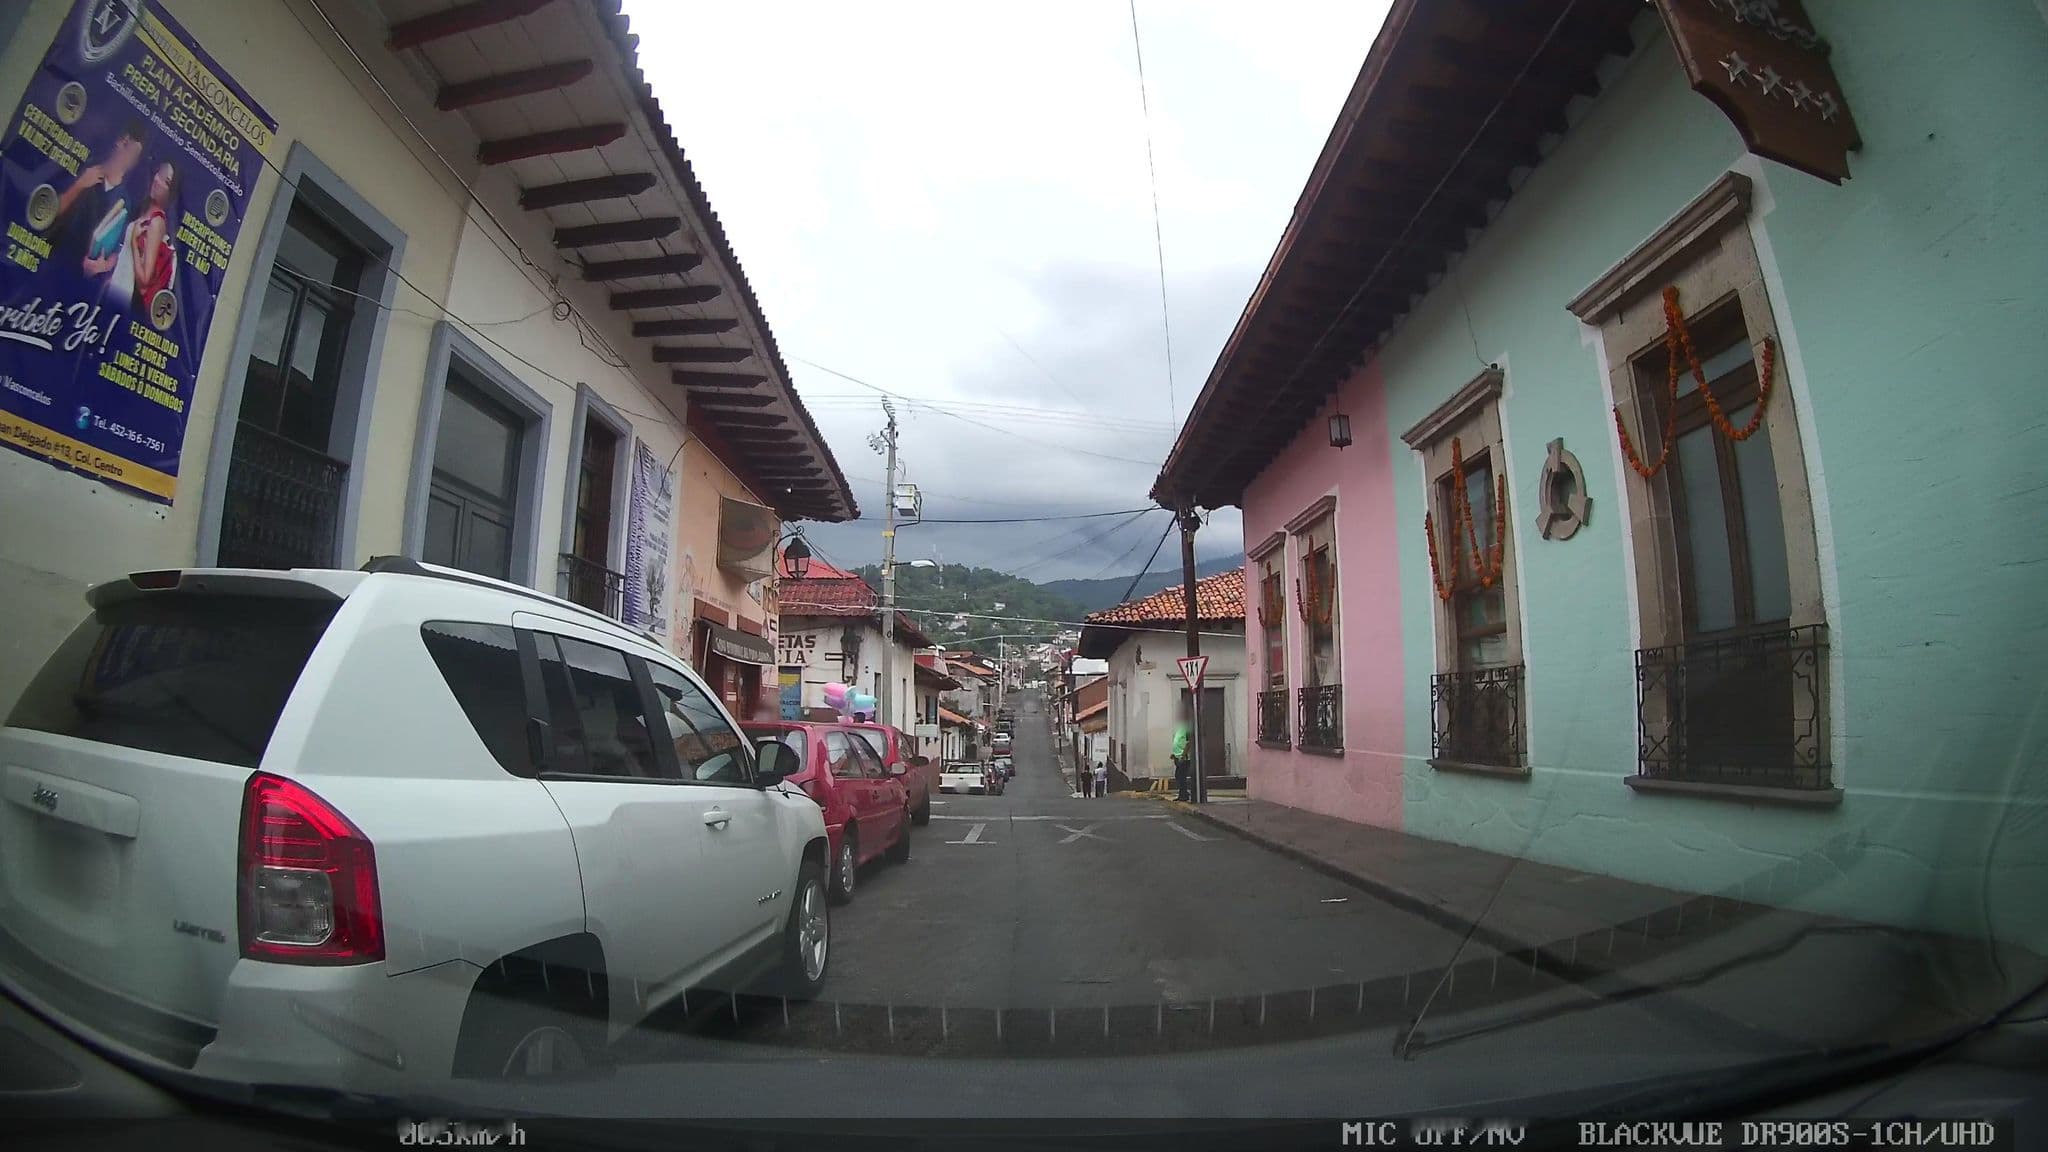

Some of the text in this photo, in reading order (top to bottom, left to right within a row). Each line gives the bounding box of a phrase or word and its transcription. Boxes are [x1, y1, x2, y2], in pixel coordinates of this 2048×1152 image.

[105, 72, 150, 117] Bachillerato
[151, 111, 185, 146] Intensivo
[124, 63, 240, 176] PREPA Y SECUNDARIA
[143, 54, 240, 151] PLAN ACADÉMICO
[187, 58, 267, 147] VASCONCELOS
[6, 244, 17, 260] 2
[65, 302, 120, 354] Ya!
[130, 321, 179, 358] FLEXIBILIDAD
[115, 350, 178, 393] LUNES A VIERNES
[134, 343, 168, 370] 2 HORAS
[143, 384, 184, 414] DOMINGOS
[13, 425, 52, 450] Delgado
[75, 449, 92, 466] Col.
[94, 457, 123, 477] Centro
[109, 422, 165, 453] 452-166-7561
